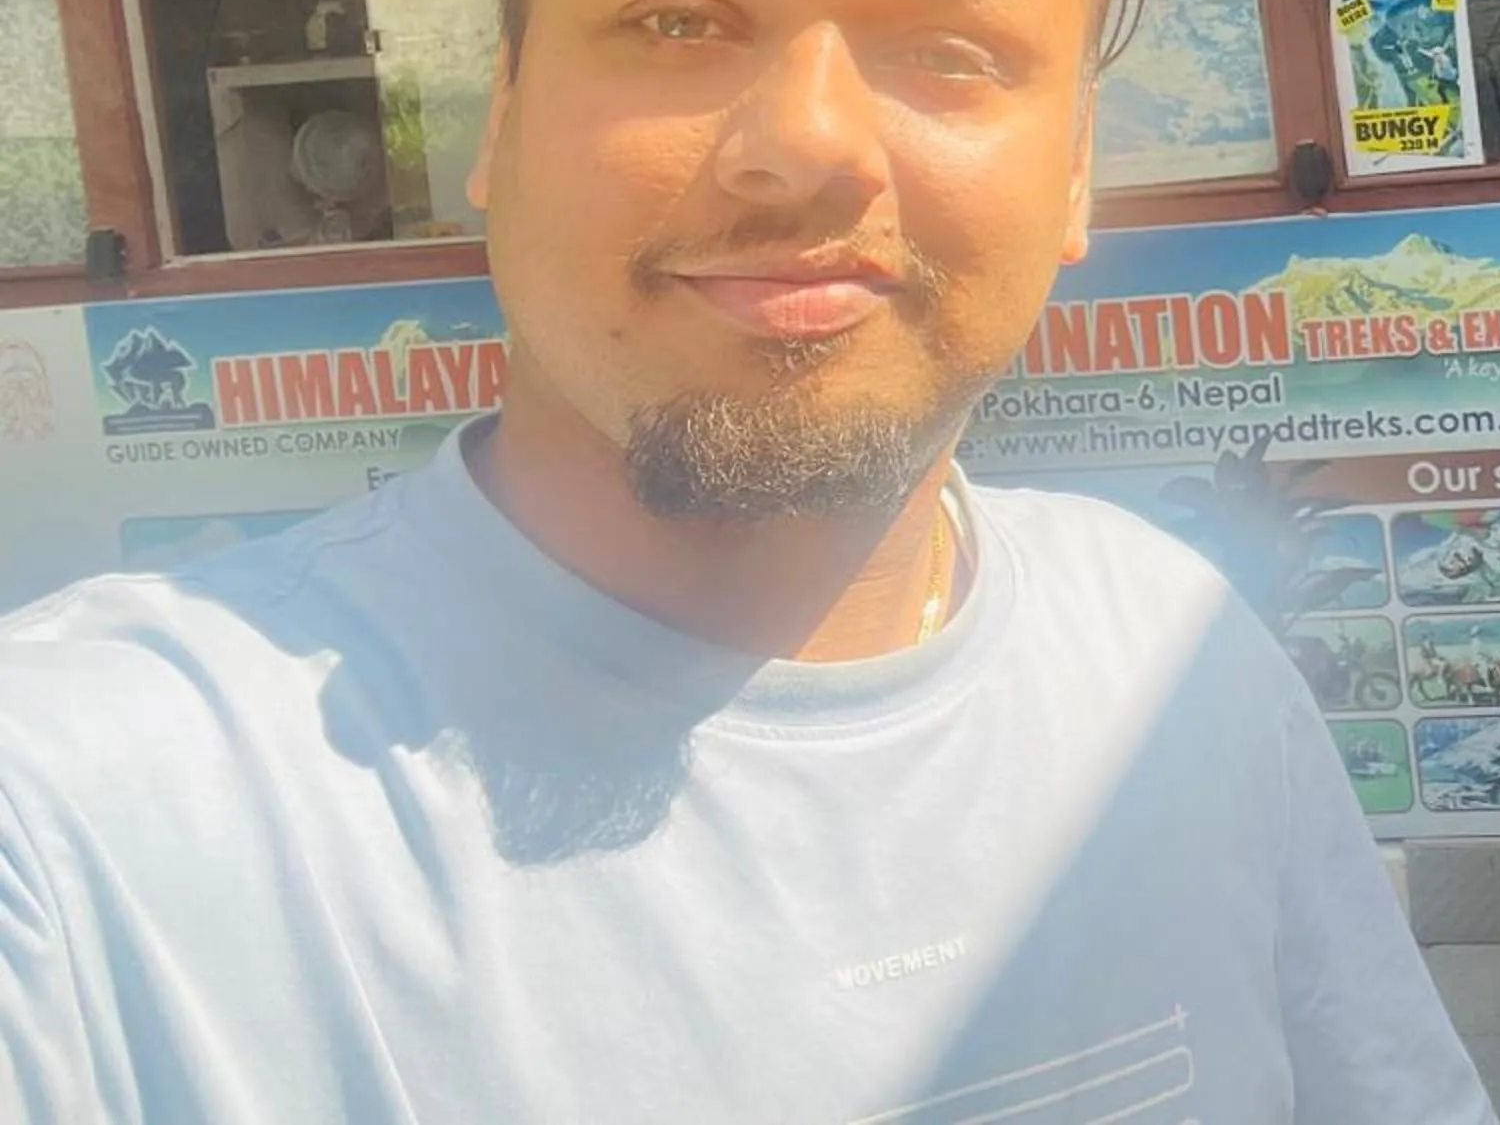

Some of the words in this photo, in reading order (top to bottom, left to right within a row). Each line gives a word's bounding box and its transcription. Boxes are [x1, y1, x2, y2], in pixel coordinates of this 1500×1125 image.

[1355, 116, 1439, 142] BUNGY
[1006, 291, 1291, 375] INATION
[1302, 315, 1418, 360] TREKS
[1428, 318, 1455, 353] &
[982, 383, 1165, 419] Pokhara-6,
[1178, 376, 1282, 411] Nepal
[105, 441, 176, 465] GUIDE
[183, 437, 269, 460] OWNED
[275, 428, 400, 453] COMPANY
[1408, 461, 1481, 494] Our
[836, 935, 967, 988] MOVEMENT
